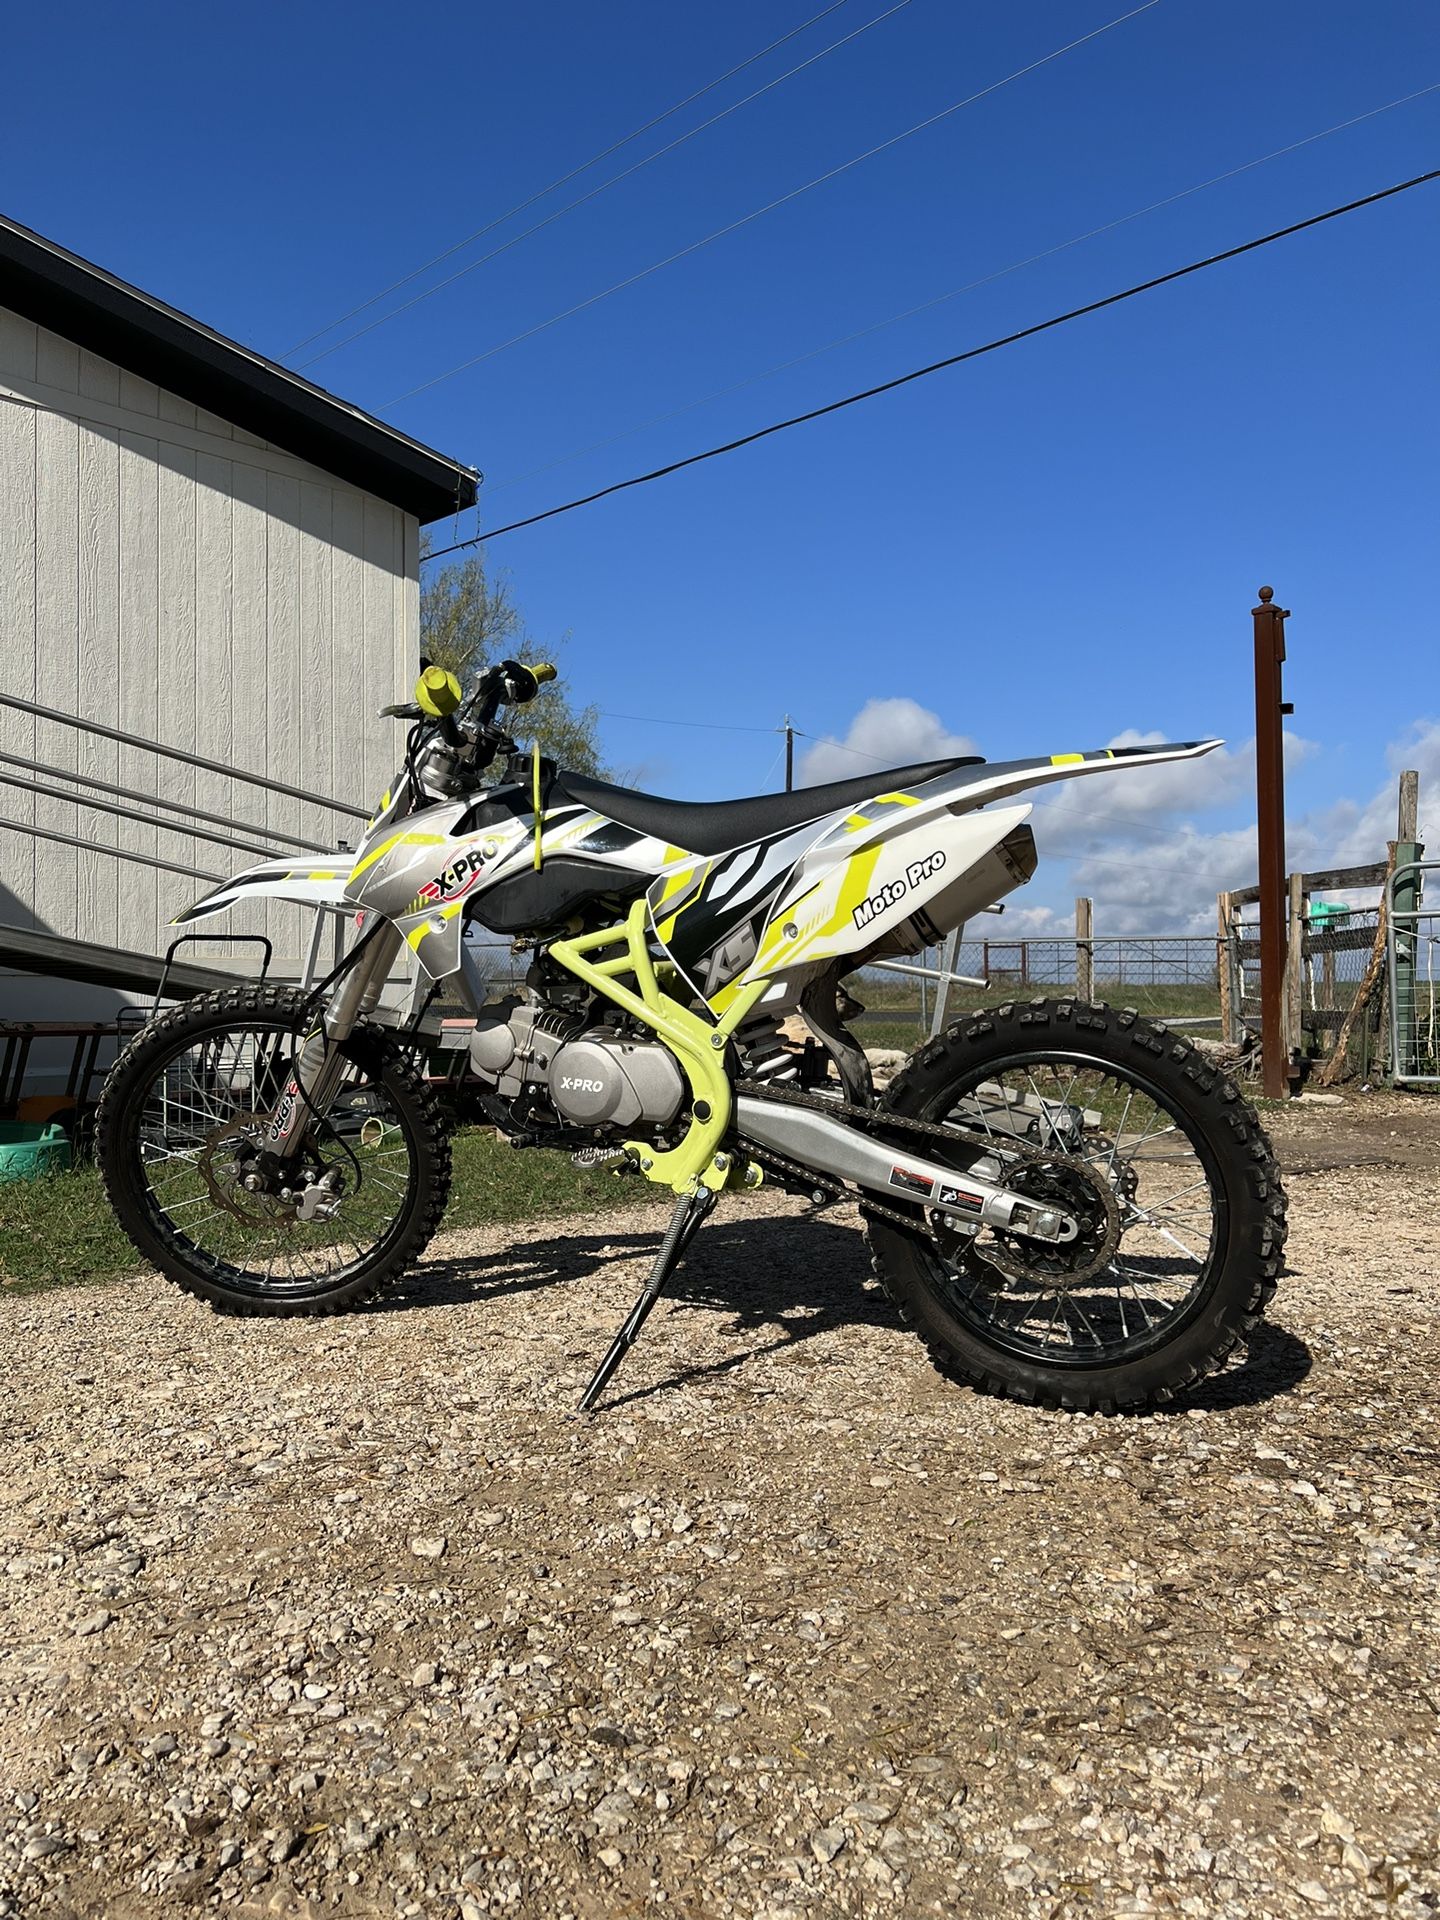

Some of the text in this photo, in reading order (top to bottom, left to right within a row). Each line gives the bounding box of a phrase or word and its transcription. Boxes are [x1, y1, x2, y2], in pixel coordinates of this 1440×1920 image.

[432, 838, 498, 897] X-PRO
[852, 851, 946, 930] Moto Pro
[270, 1090, 298, 1140] X-PRO
